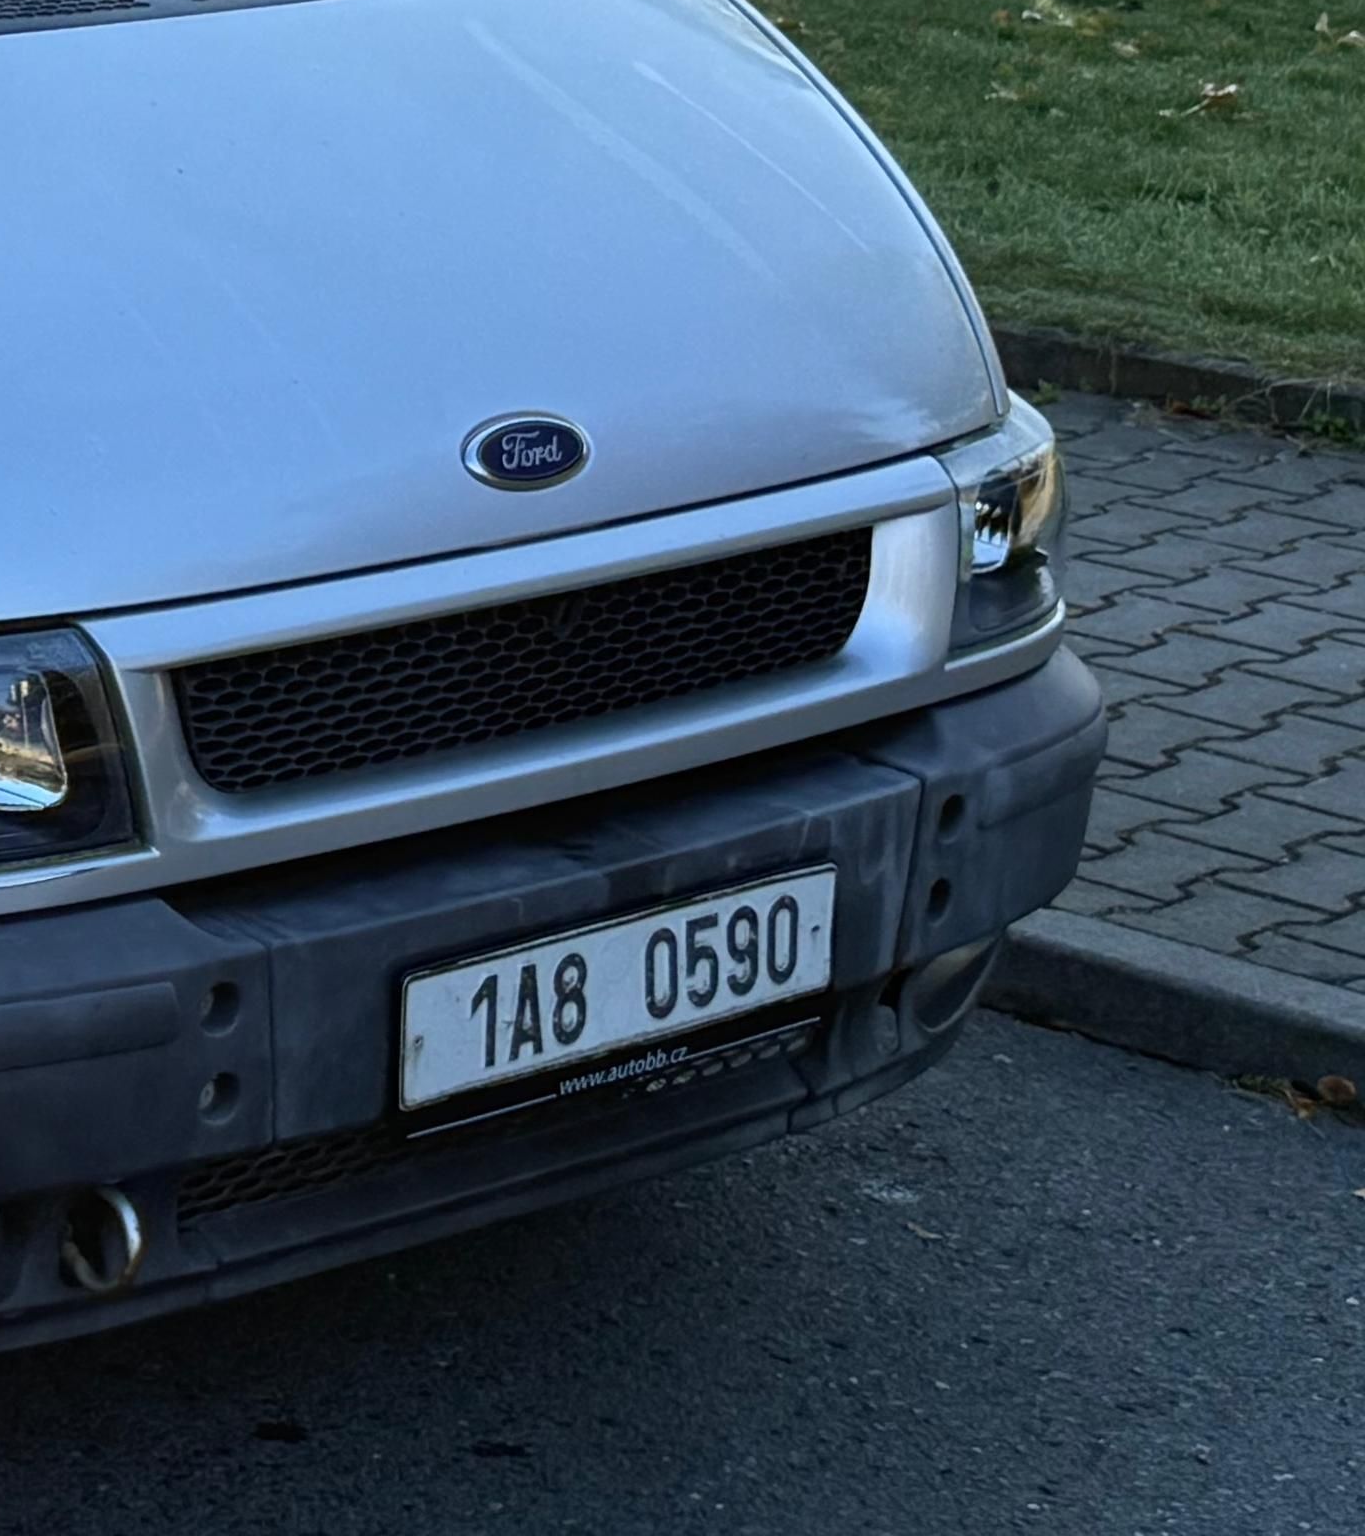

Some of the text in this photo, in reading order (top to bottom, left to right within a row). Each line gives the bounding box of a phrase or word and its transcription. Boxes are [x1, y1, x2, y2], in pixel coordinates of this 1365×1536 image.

[501, 430, 563, 470] Ford
[469, 894, 799, 1068] 1A8 0590
[559, 1046, 688, 1096] www.autobb.cz
